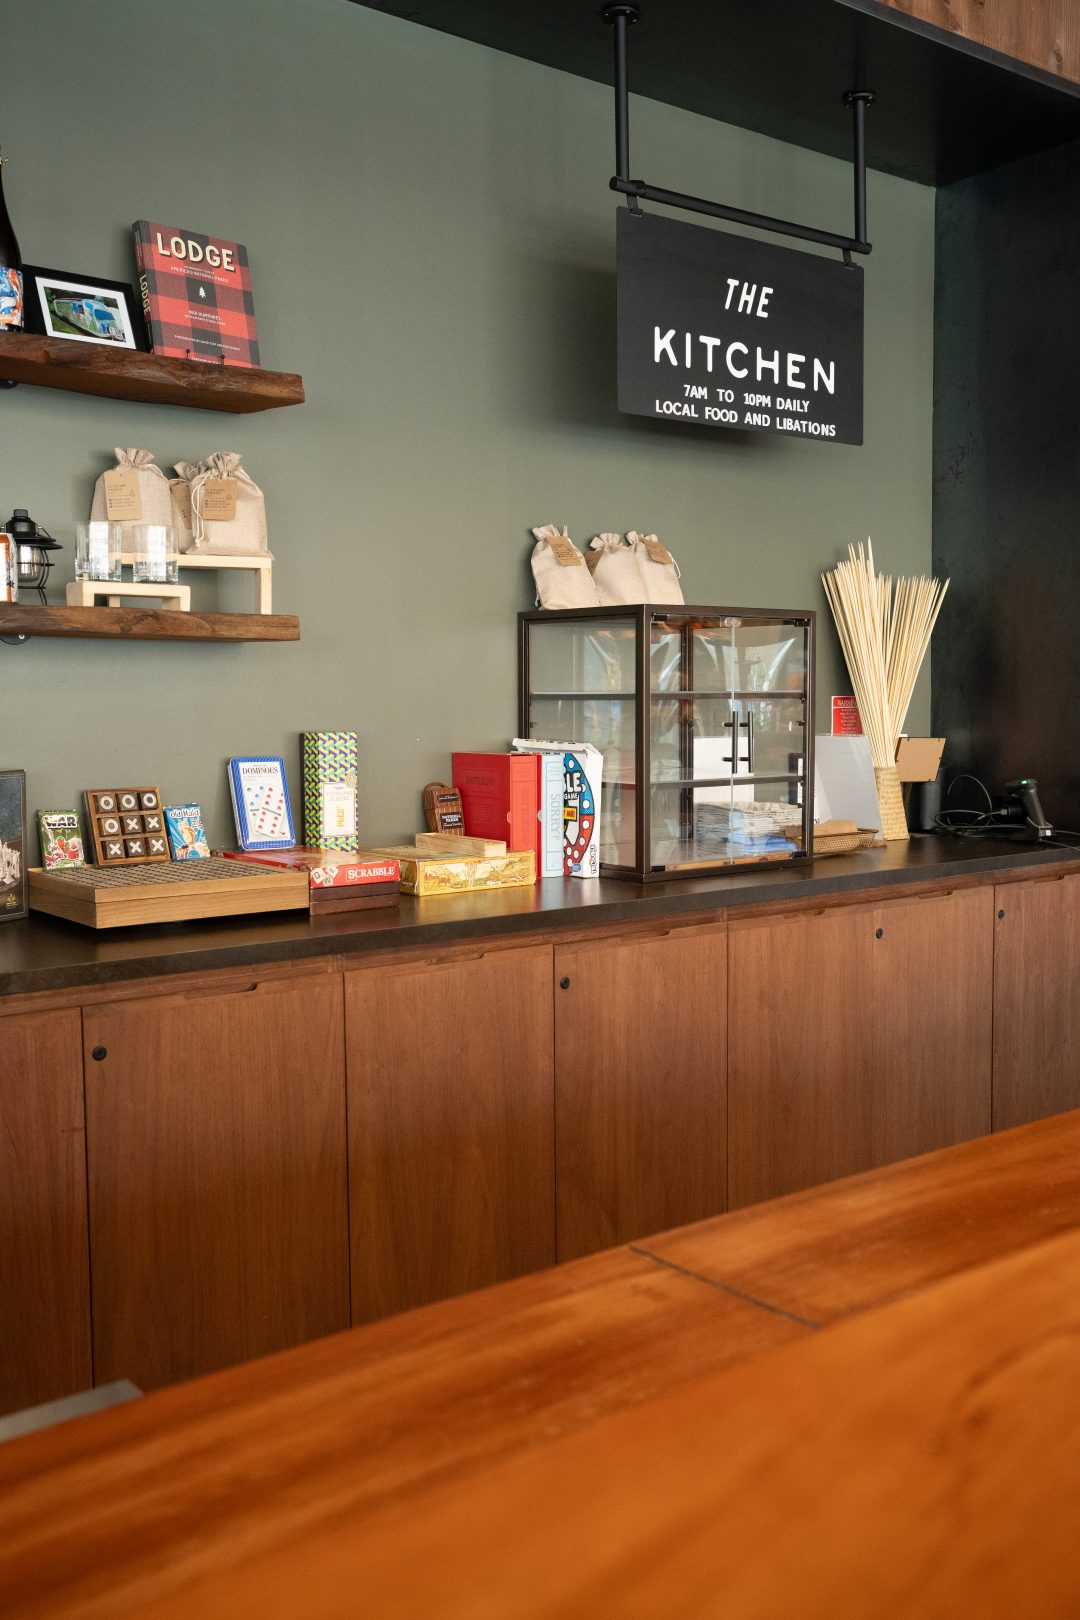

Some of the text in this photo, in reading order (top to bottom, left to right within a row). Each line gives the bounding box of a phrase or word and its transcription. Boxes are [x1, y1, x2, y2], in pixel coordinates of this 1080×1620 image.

[156, 232, 235, 271] LODGE
[138, 273, 151, 315] LODGE
[724, 278, 774, 318] THE
[654, 326, 835, 395] KITCHEN
[683, 384, 809, 413] 7AM TO 10PM DAILY
[655, 400, 836, 437] LOCAL FOOD AND LIBATIONS
[242, 766, 279, 775] DOMINOES
[44, 816, 76, 827] WAR
[348, 866, 395, 879] SCRABBLE
